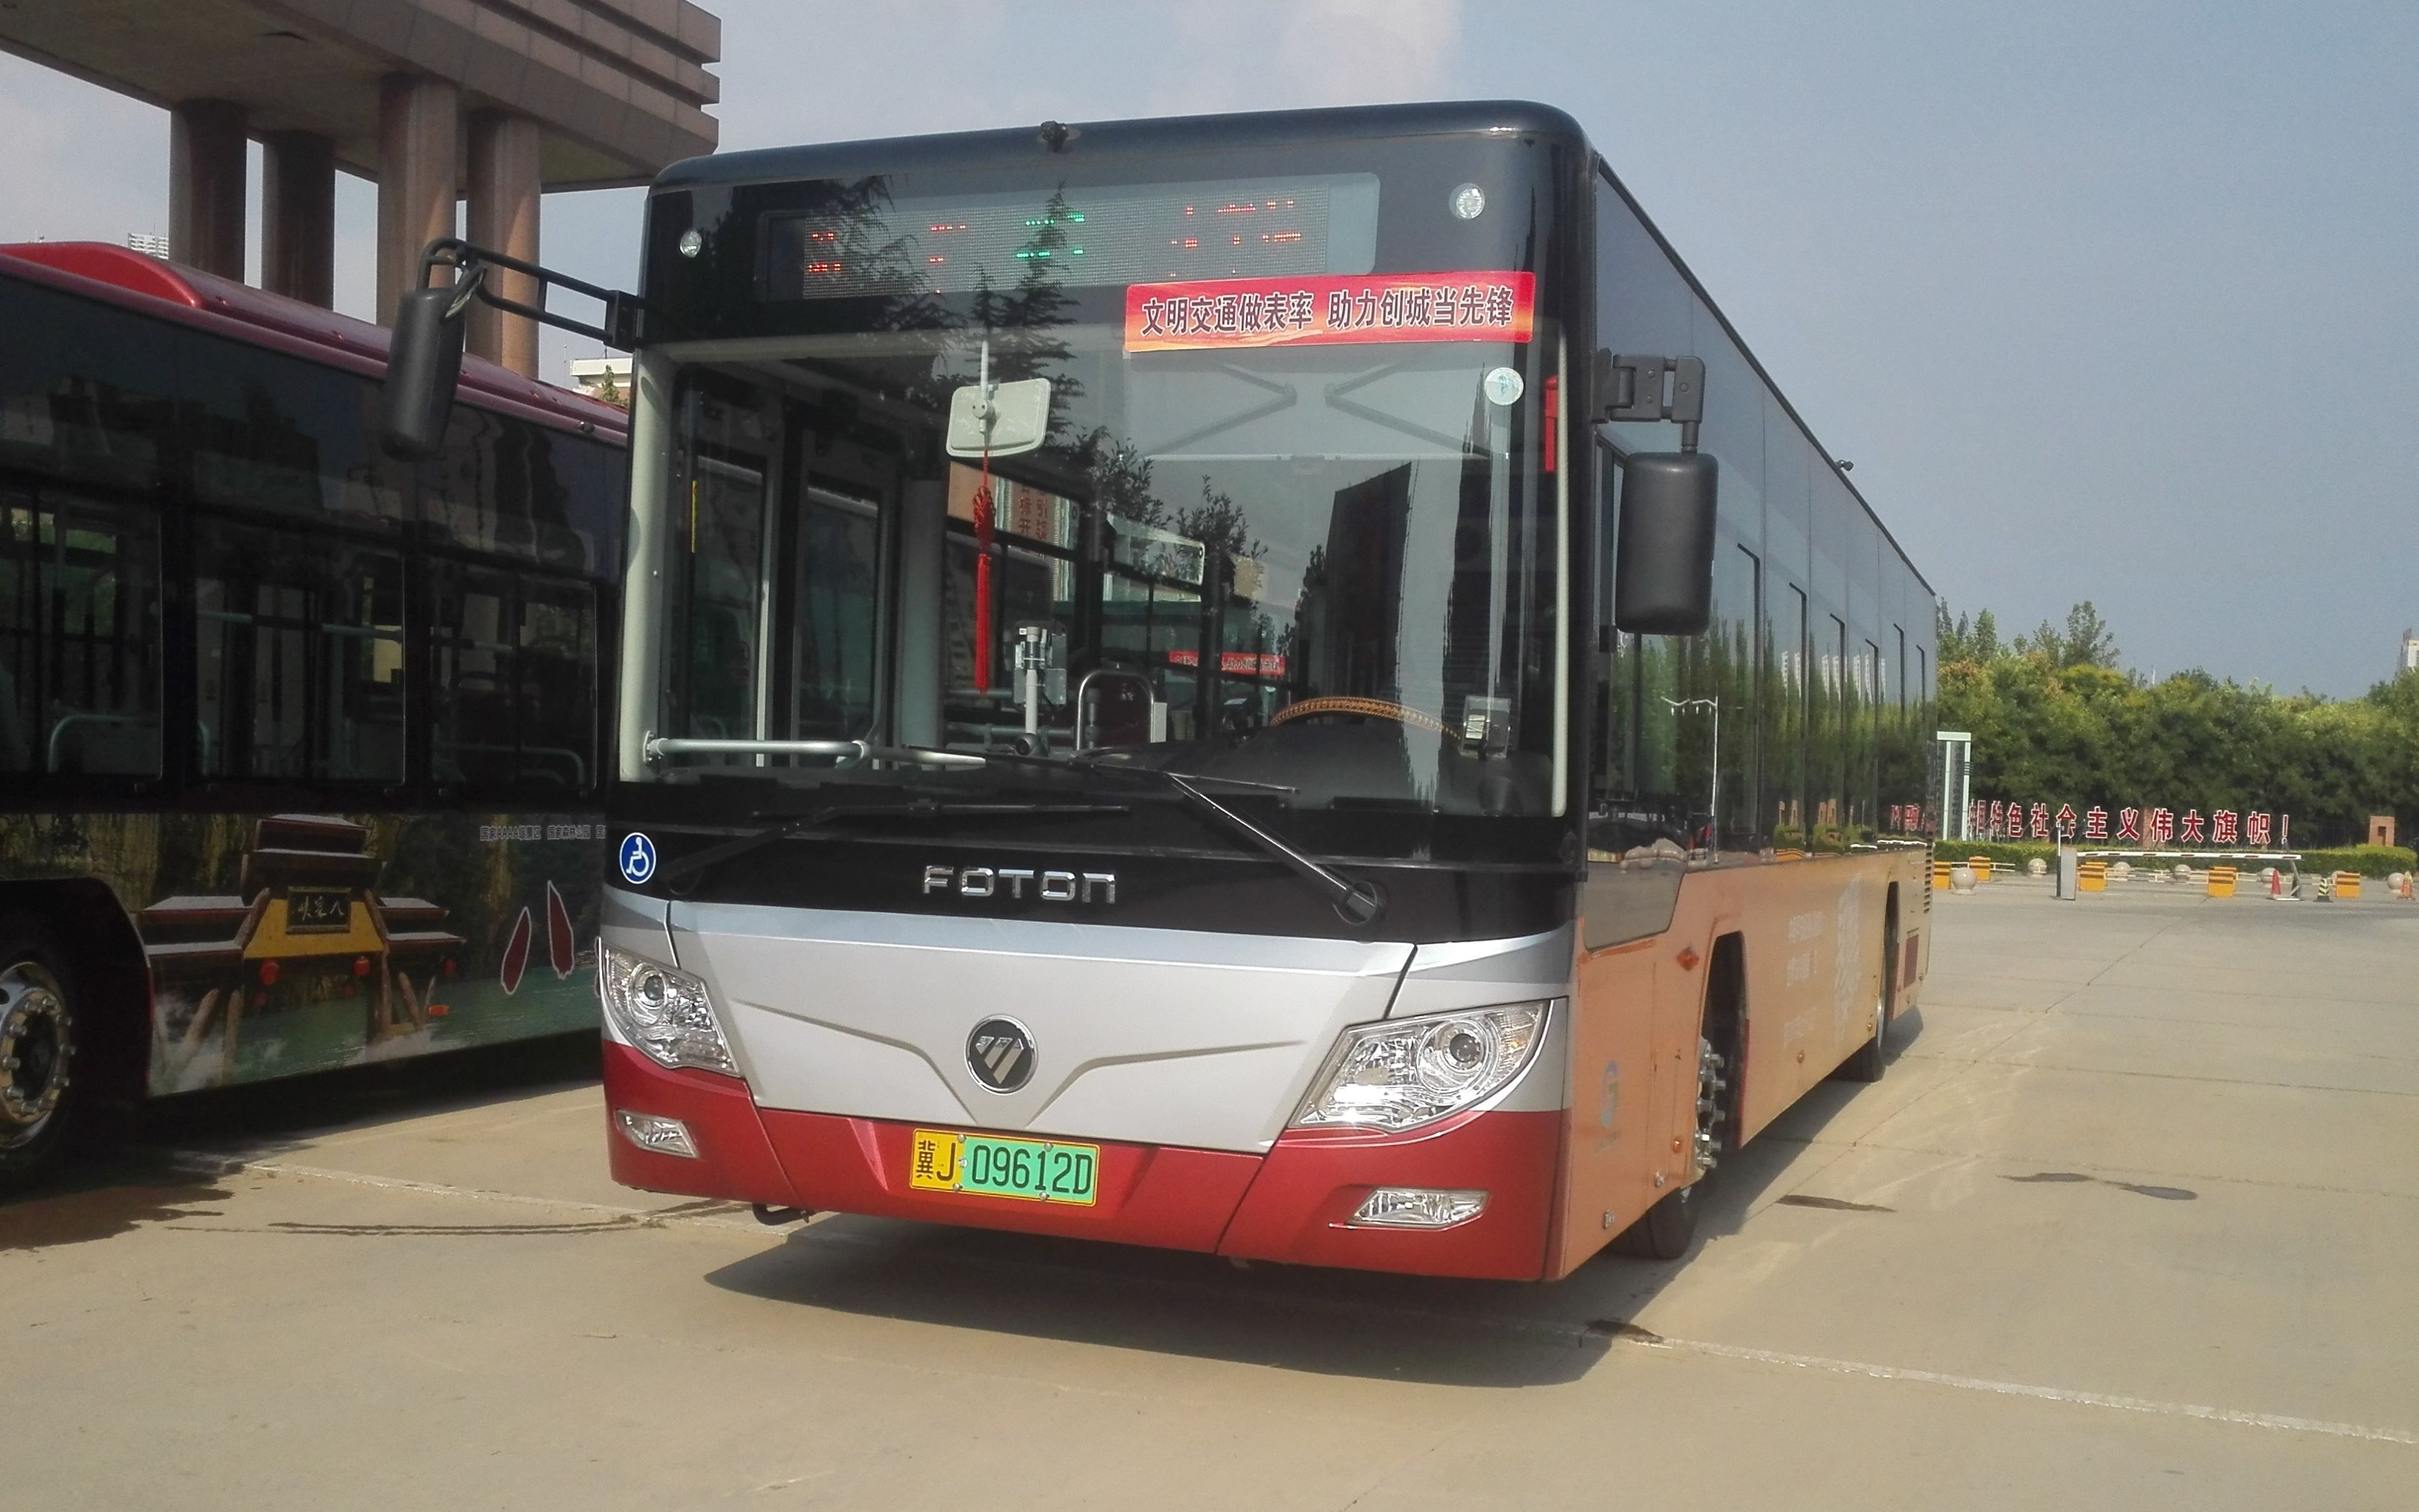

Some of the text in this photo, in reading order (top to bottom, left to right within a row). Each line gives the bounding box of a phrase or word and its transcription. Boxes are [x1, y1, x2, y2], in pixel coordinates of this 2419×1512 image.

[1141, 286, 1514, 336] 文明交通做表率 助力创城当先锋
[923, 865, 1116, 904] FOTON
[972, 1144, 1093, 1194] 09612D
